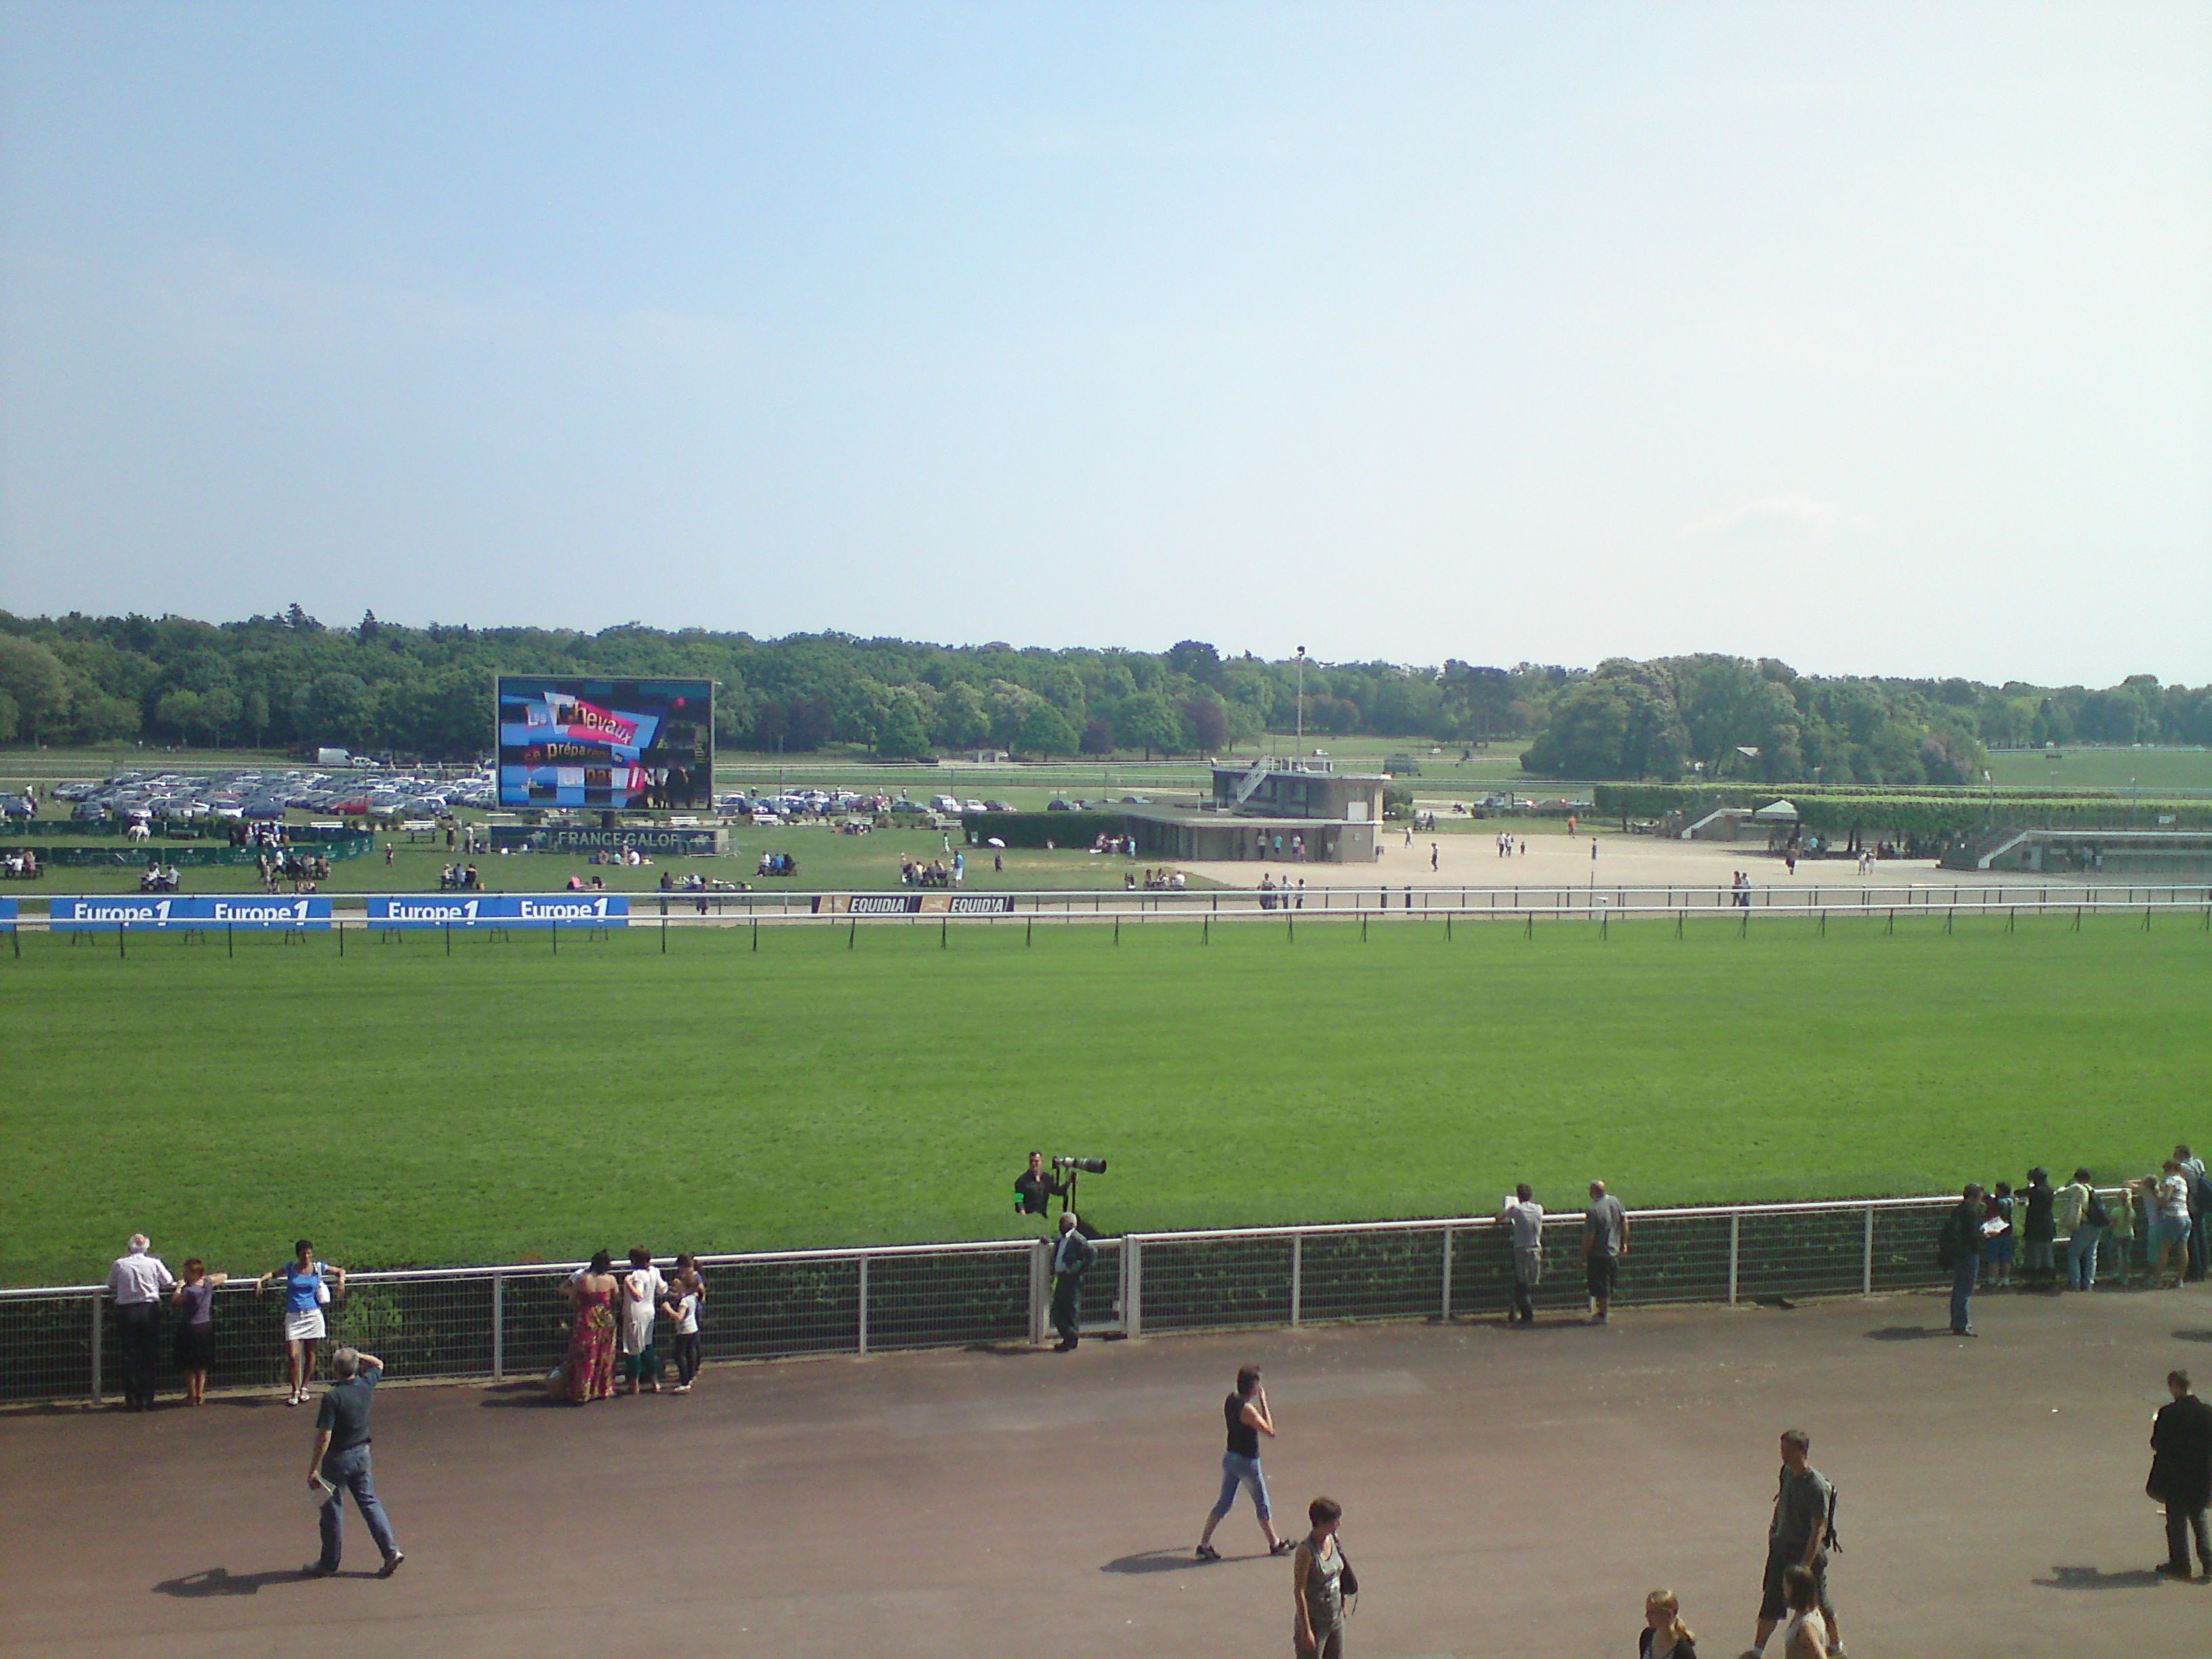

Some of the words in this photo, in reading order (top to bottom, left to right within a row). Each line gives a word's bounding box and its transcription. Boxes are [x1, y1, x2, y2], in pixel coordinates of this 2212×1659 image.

[558, 832, 625, 845] FRANCE
[626, 832, 679, 846] GALOP
[851, 898, 905, 912] EQUIDIA
[951, 899, 1004, 912] EQUIDIA
